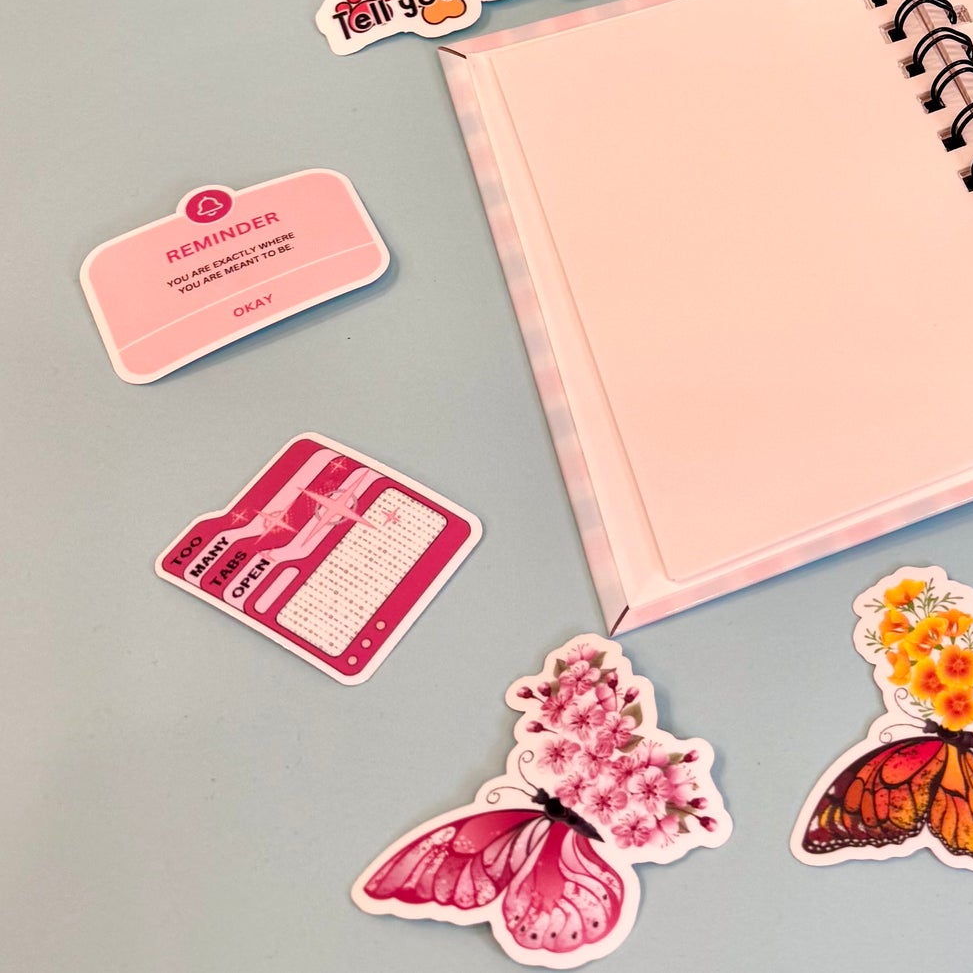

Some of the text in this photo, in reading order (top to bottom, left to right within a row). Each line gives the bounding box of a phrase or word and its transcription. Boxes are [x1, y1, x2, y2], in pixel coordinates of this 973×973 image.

[333, 0, 392, 40] Tell
[166, 212, 280, 264] REMINDER
[166, 231, 295, 288] YOU ARE EXACTLY WHERE
[178, 243, 295, 294] YOU ARE MEANT TO BE.
[233, 293, 273, 317] OKAY
[171, 535, 203, 567] TOO
[189, 536, 229, 578] MANY
[209, 550, 248, 588] TABS
[231, 558, 271, 599] OPEN
